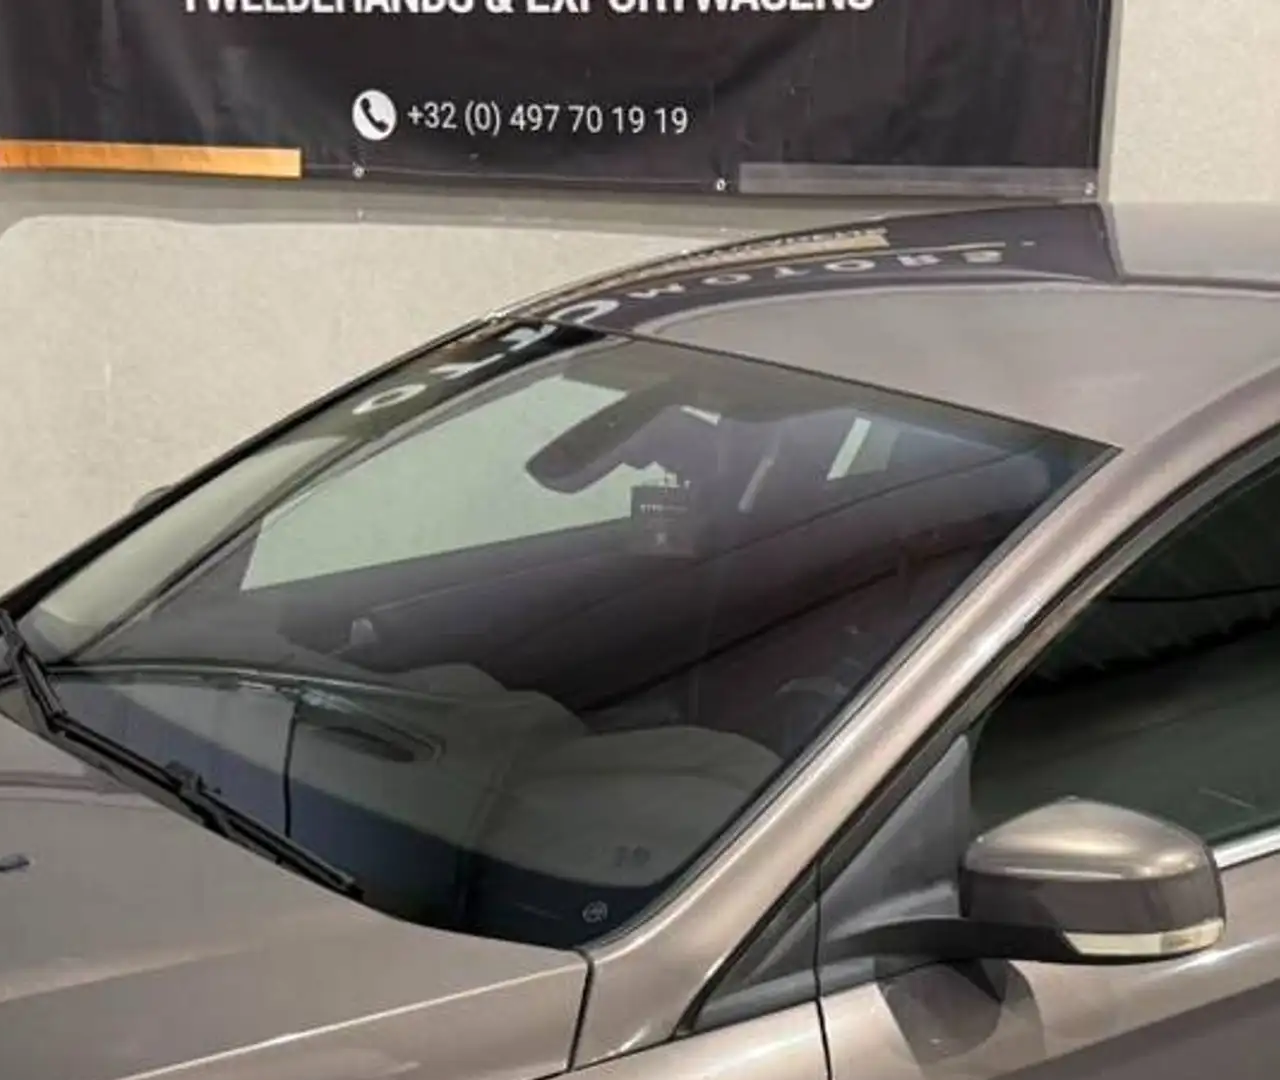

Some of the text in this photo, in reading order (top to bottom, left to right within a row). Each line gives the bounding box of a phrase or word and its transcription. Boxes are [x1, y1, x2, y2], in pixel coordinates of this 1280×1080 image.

[407, 100, 689, 137] +32 (0) 497 70 19 19
